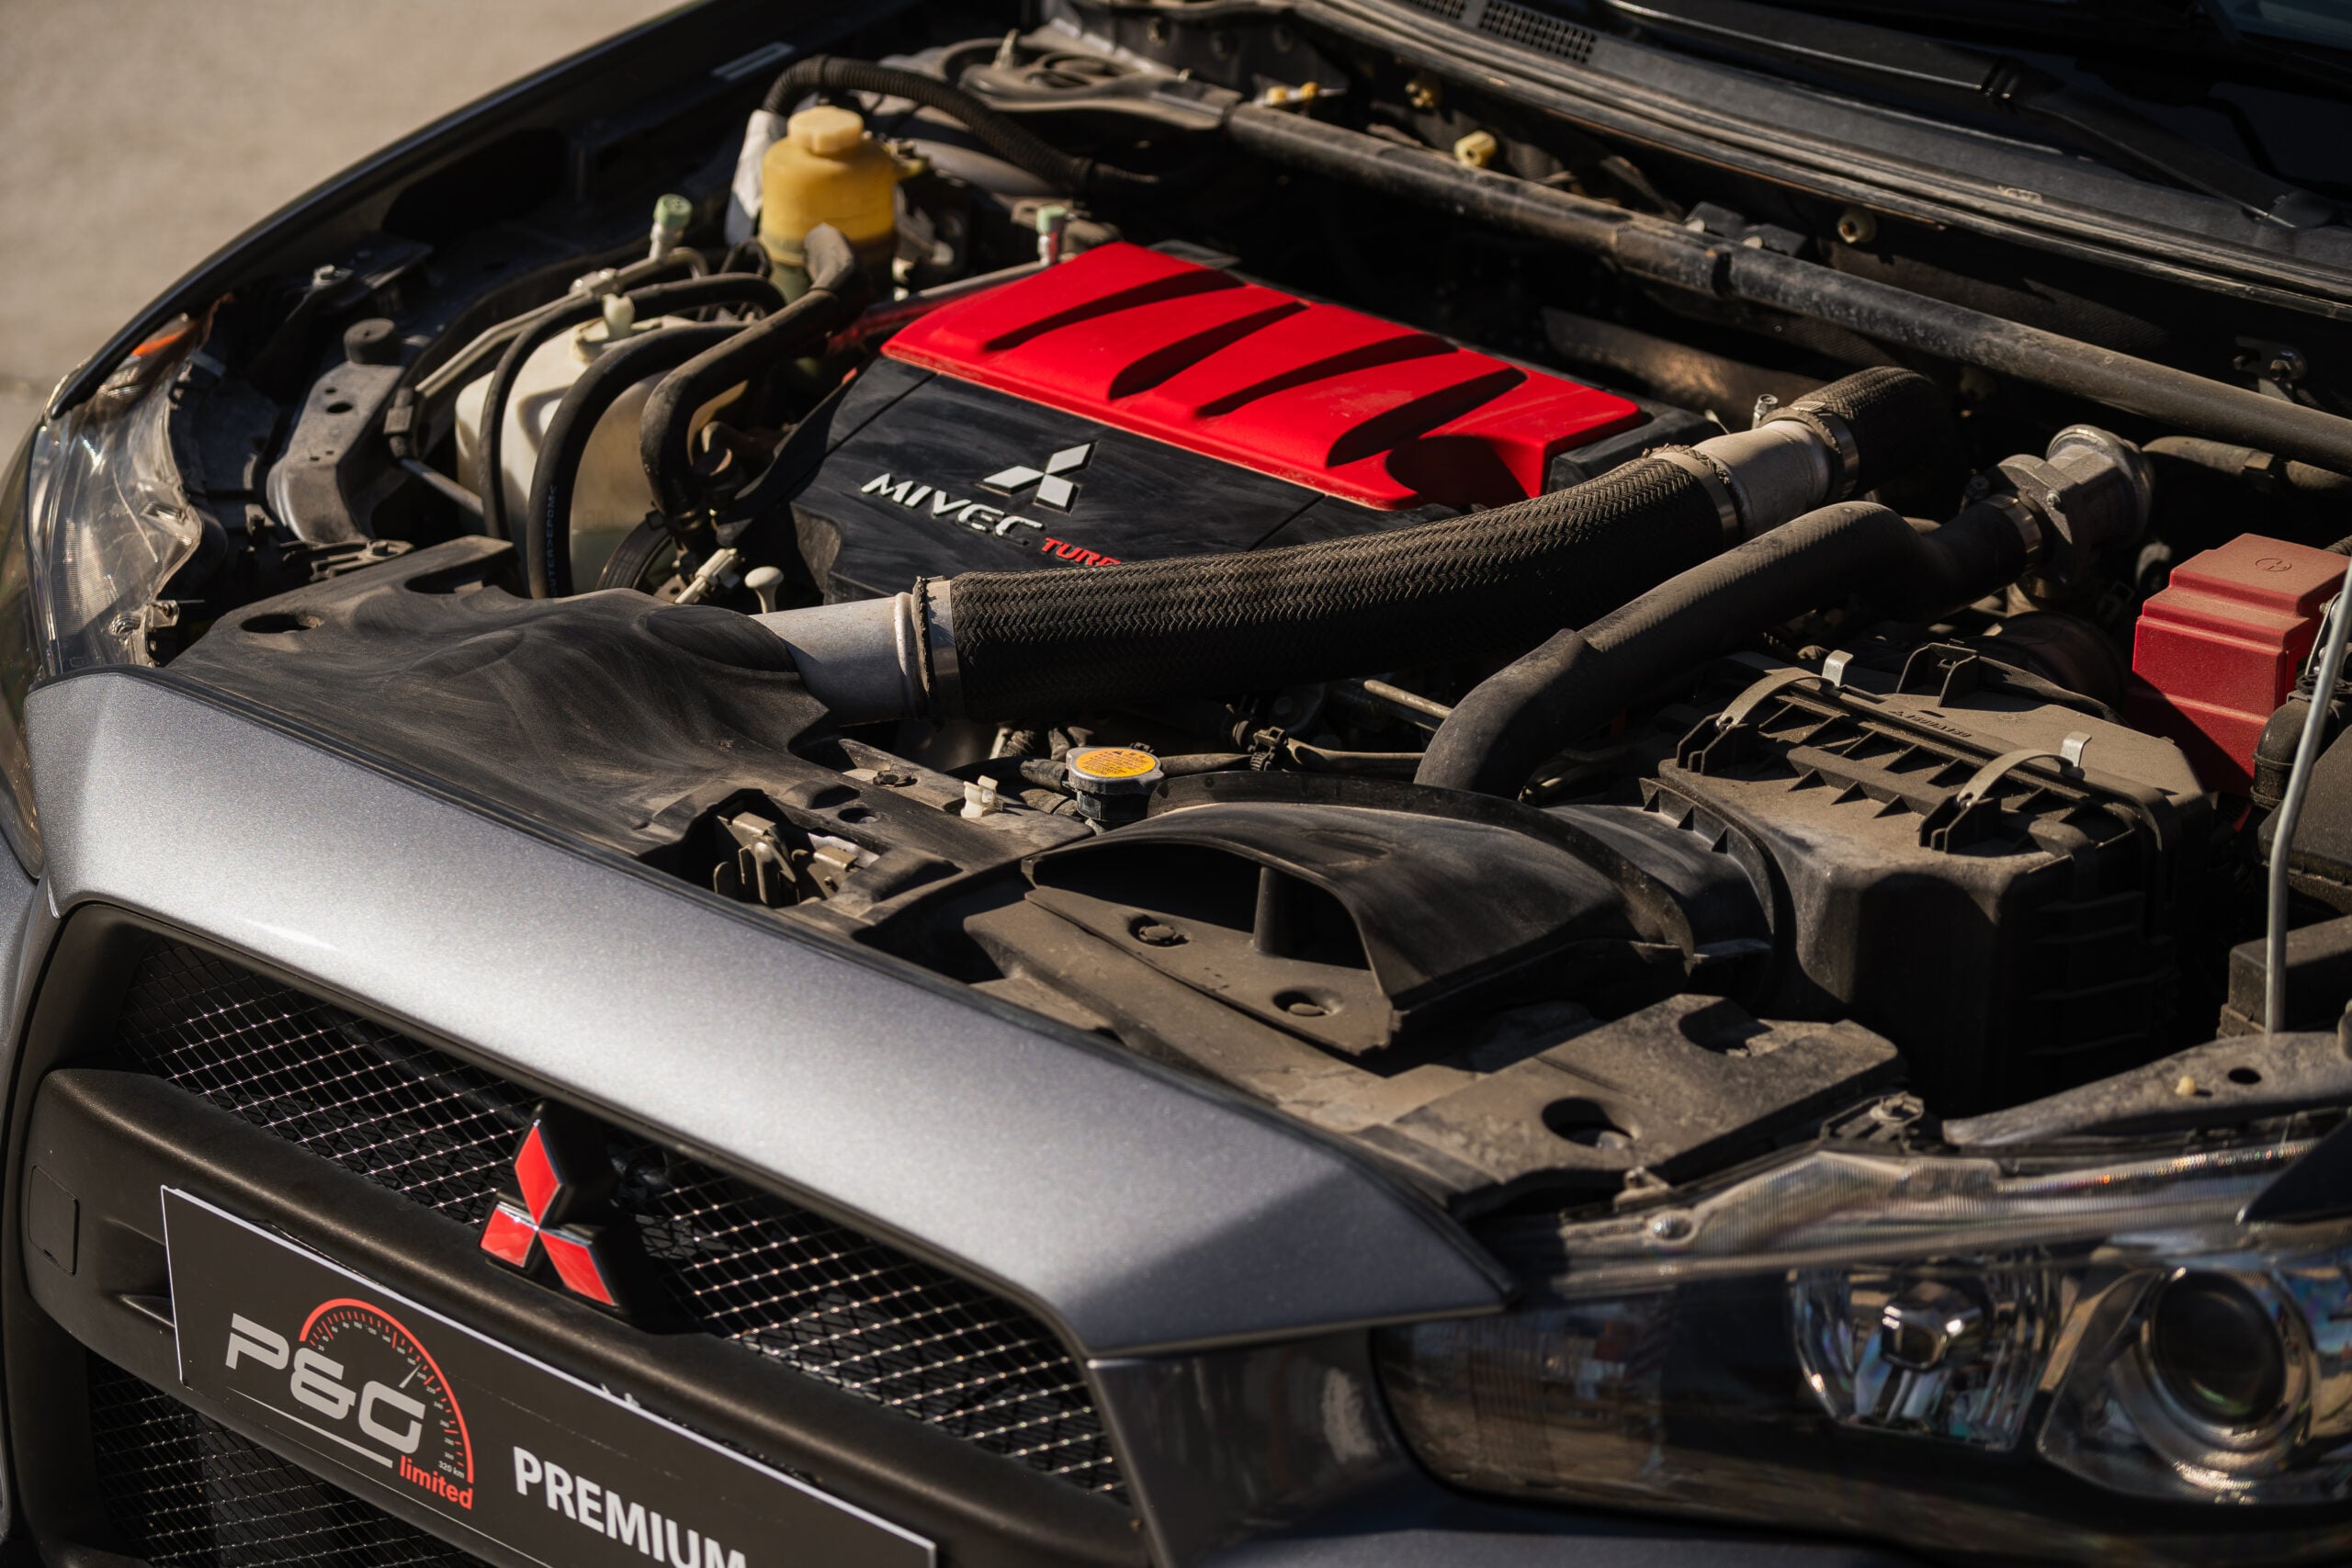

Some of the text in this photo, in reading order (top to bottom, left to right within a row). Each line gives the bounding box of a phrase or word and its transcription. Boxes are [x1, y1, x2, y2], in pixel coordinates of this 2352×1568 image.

[861, 472, 1044, 546] MIVEC
[225, 1313, 426, 1454] P&G
[400, 1454, 475, 1510] limited
[438, 1461, 466, 1480] 320 km
